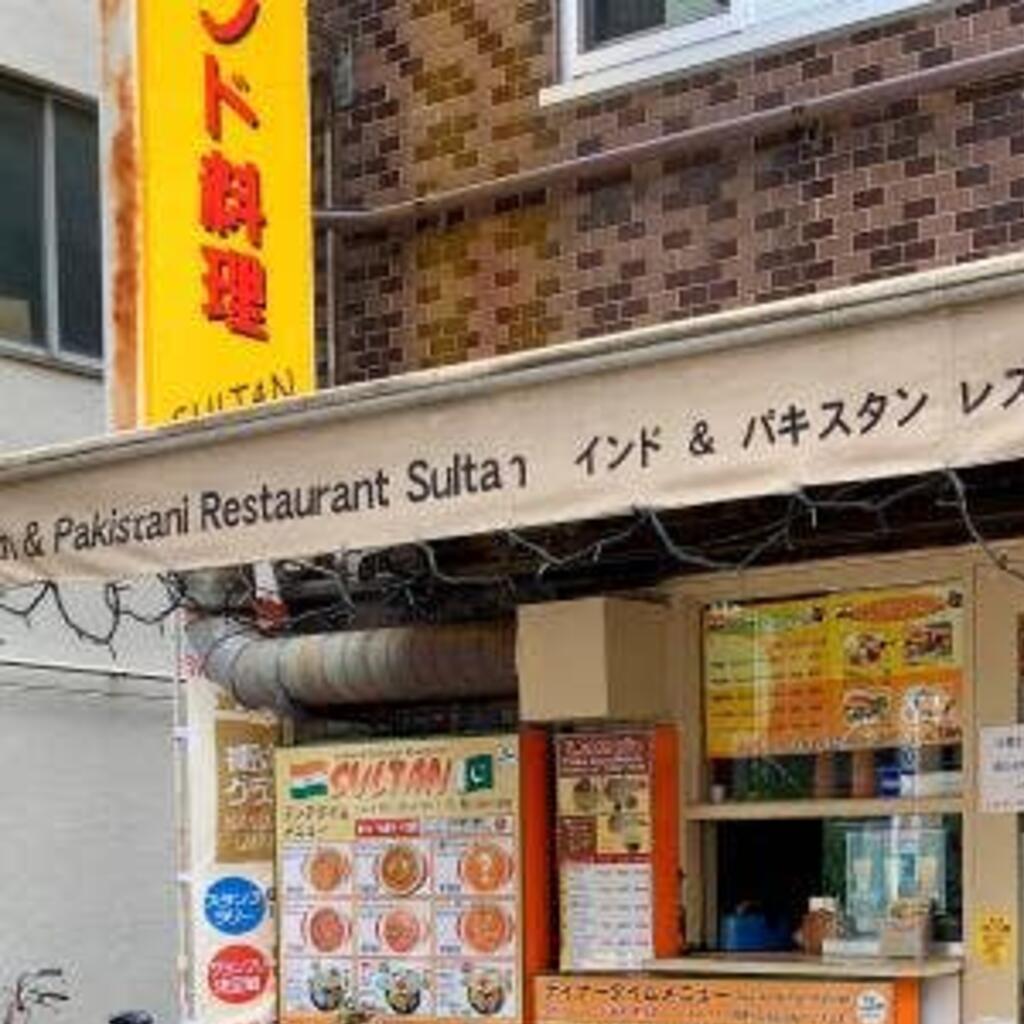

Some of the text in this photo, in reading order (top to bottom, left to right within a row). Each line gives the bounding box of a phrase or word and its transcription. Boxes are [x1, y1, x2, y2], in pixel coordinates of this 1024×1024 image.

[575, 425, 662, 475] インド
[688, 420, 715, 455] &
[23, 521, 46, 557] &
[53, 494, 189, 554] Pakistani
[200, 470, 390, 531] Restaurant
[405, 453, 527, 503] Sultan
